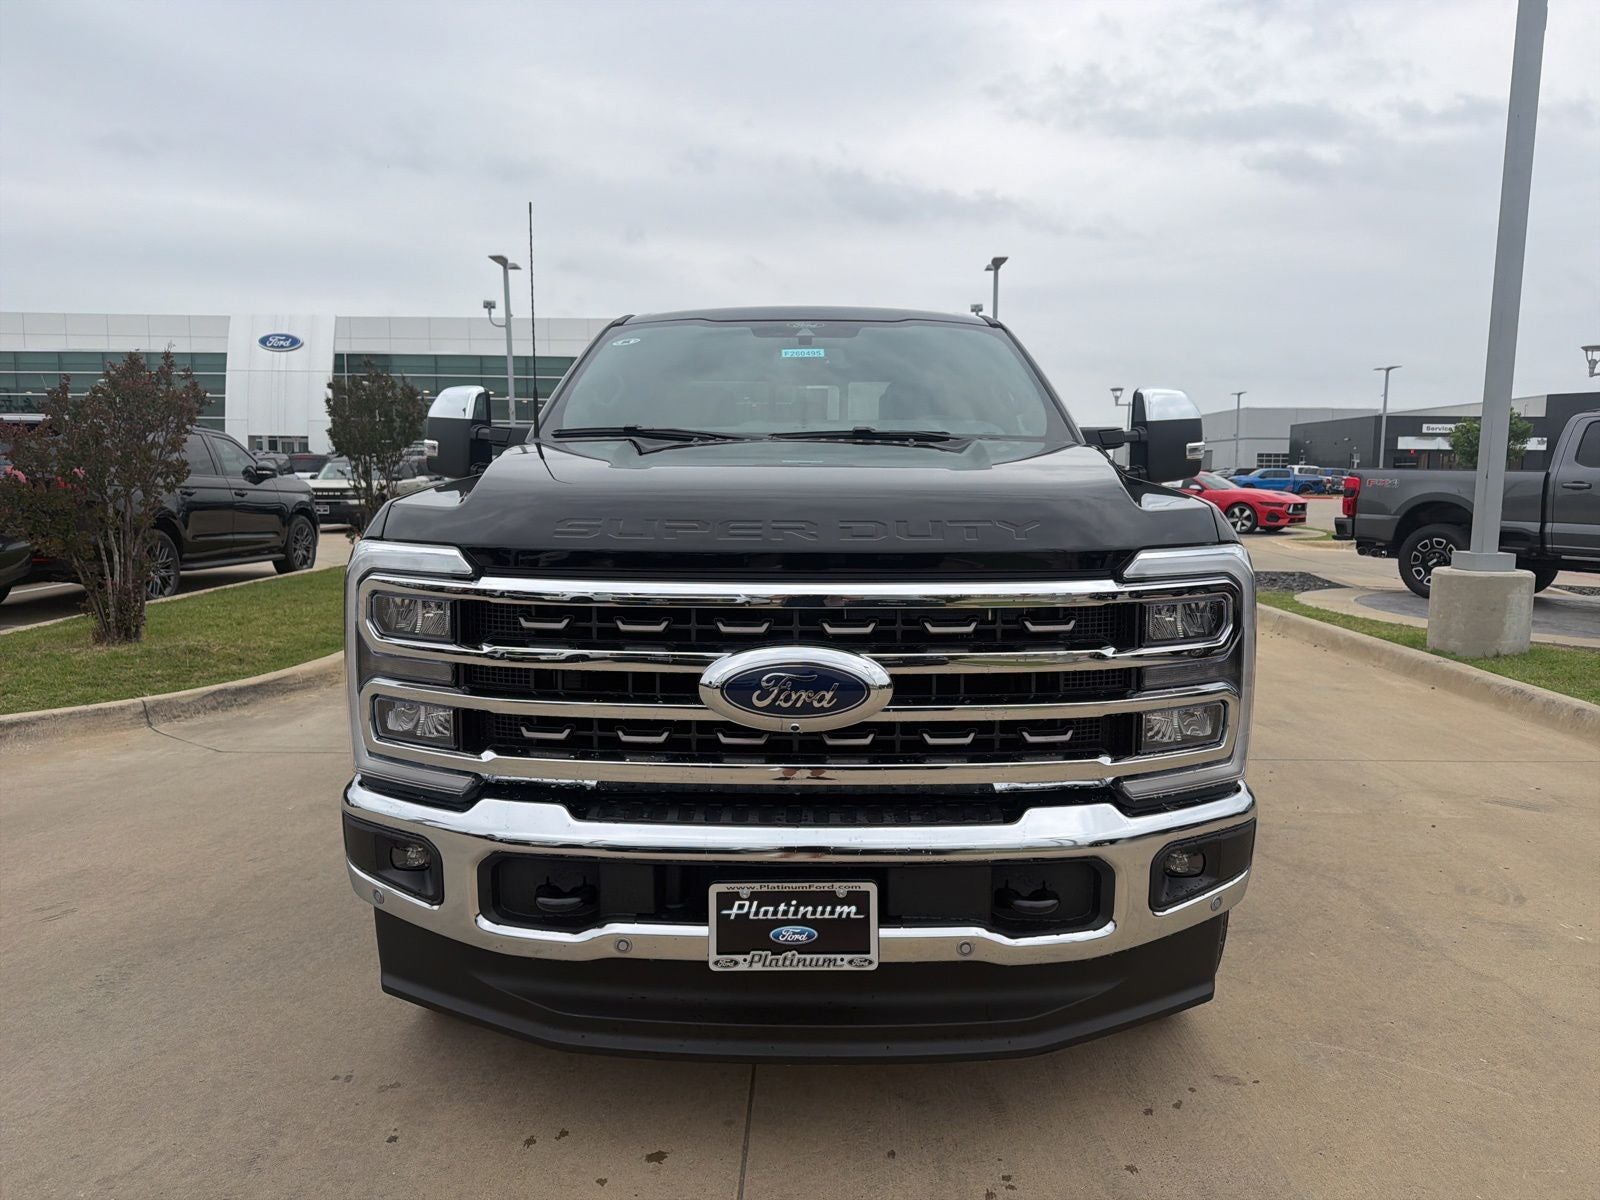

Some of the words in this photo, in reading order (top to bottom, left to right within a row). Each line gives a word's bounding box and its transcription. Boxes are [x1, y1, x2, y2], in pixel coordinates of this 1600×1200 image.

[266, 335, 292, 347] Ford
[553, 518, 818, 541] SUPER
[839, 519, 1041, 541] DUTY
[751, 672, 840, 708] Ford
[720, 900, 865, 920] Platinum
[778, 928, 809, 942] Ford
[747, 952, 845, 968] Platinum
